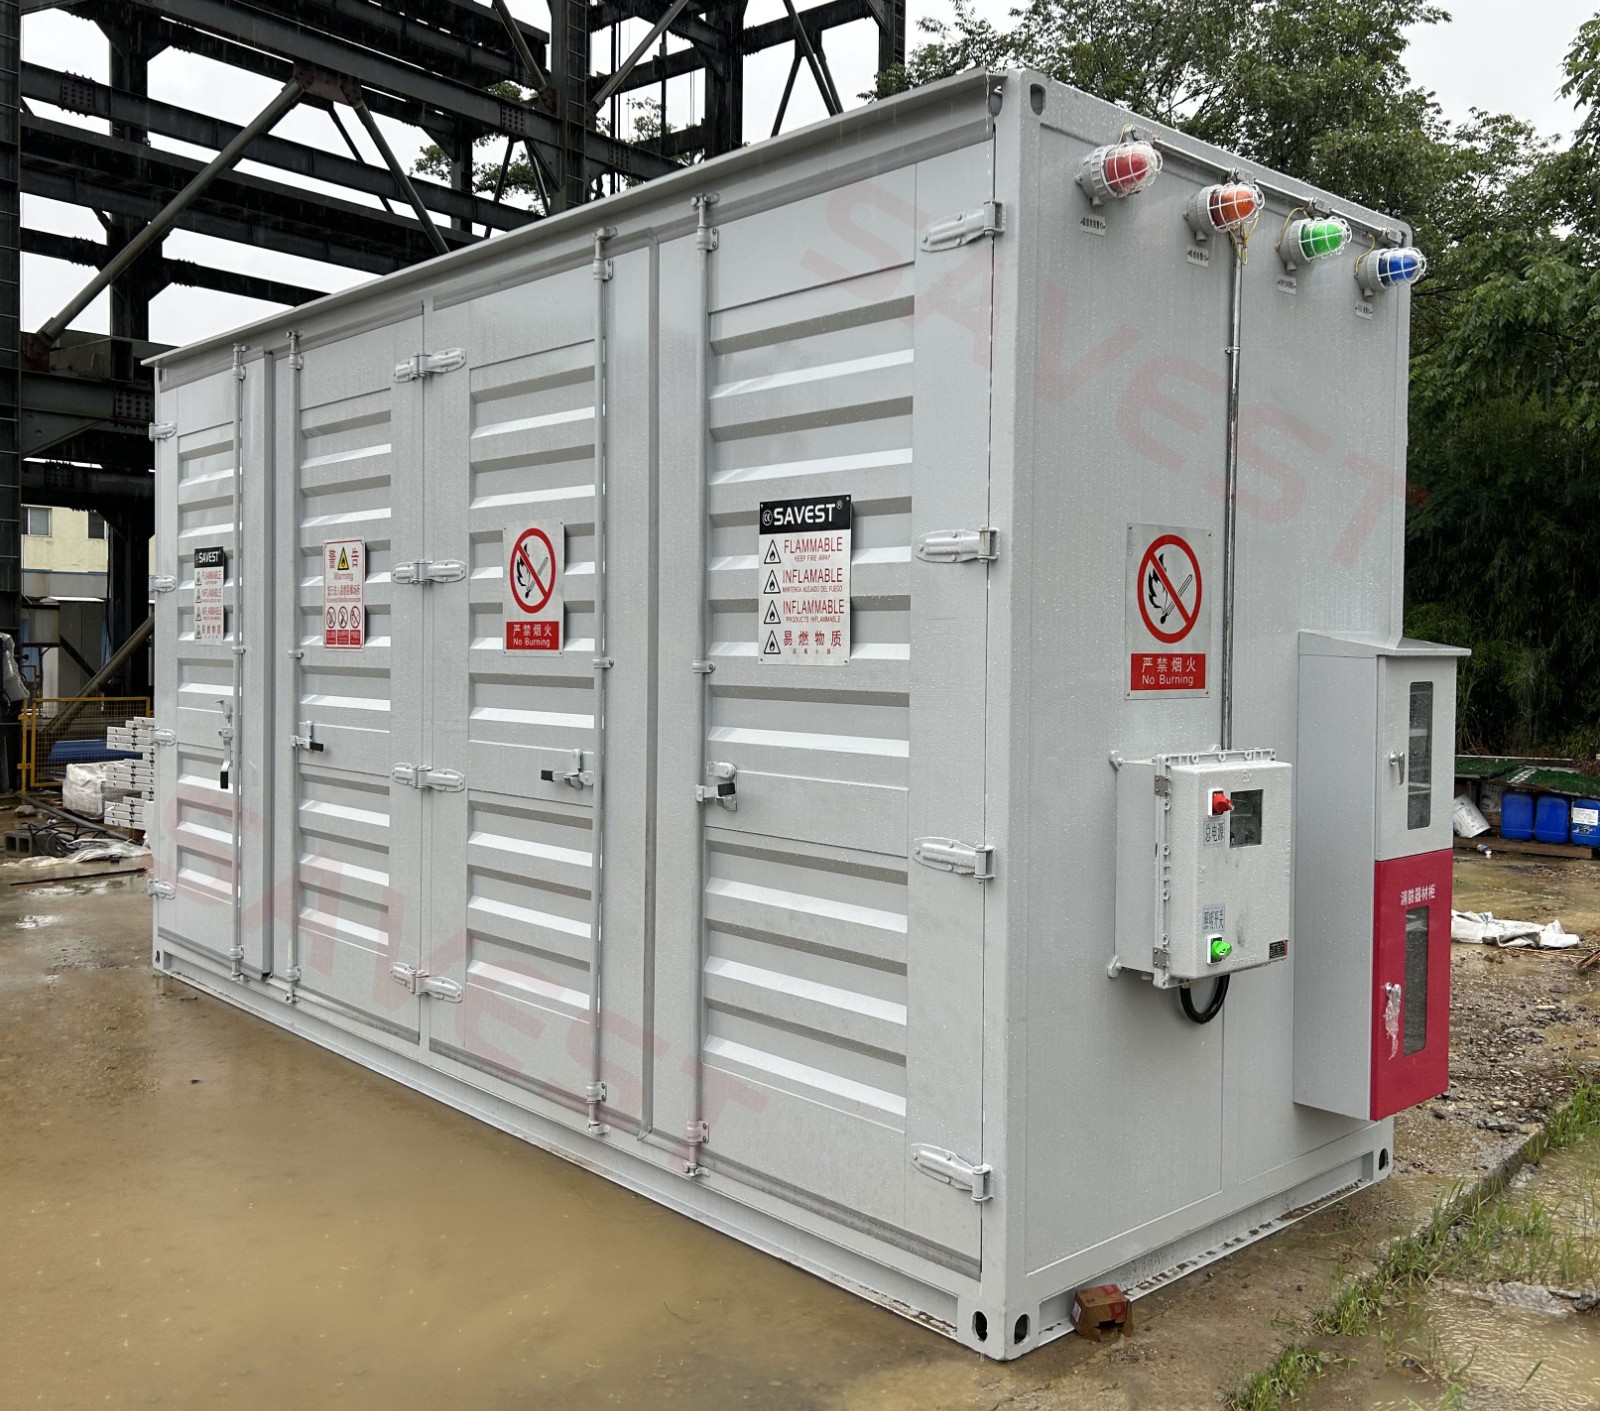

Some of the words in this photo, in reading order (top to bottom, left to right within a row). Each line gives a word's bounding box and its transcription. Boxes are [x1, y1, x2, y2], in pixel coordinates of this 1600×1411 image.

[784, 536, 843, 554] FLAMMABLE
[351, 547, 359, 568] 告
[794, 554, 806, 562] KEEP
[782, 567, 843, 584] INFLAMABLE
[783, 599, 845, 615] INFLAMMABLE
[512, 623, 553, 637] 严禁烟火
[783, 630, 842, 647] 易燃物质
[513, 638, 523, 646] No
[524, 637, 551, 648] Burning
[1141, 656, 1197, 673] 严禁烟火
[1142, 674, 1156, 685] No
[1159, 673, 1194, 686] Burning
[1400, 884, 1436, 906] 消防器材柜
